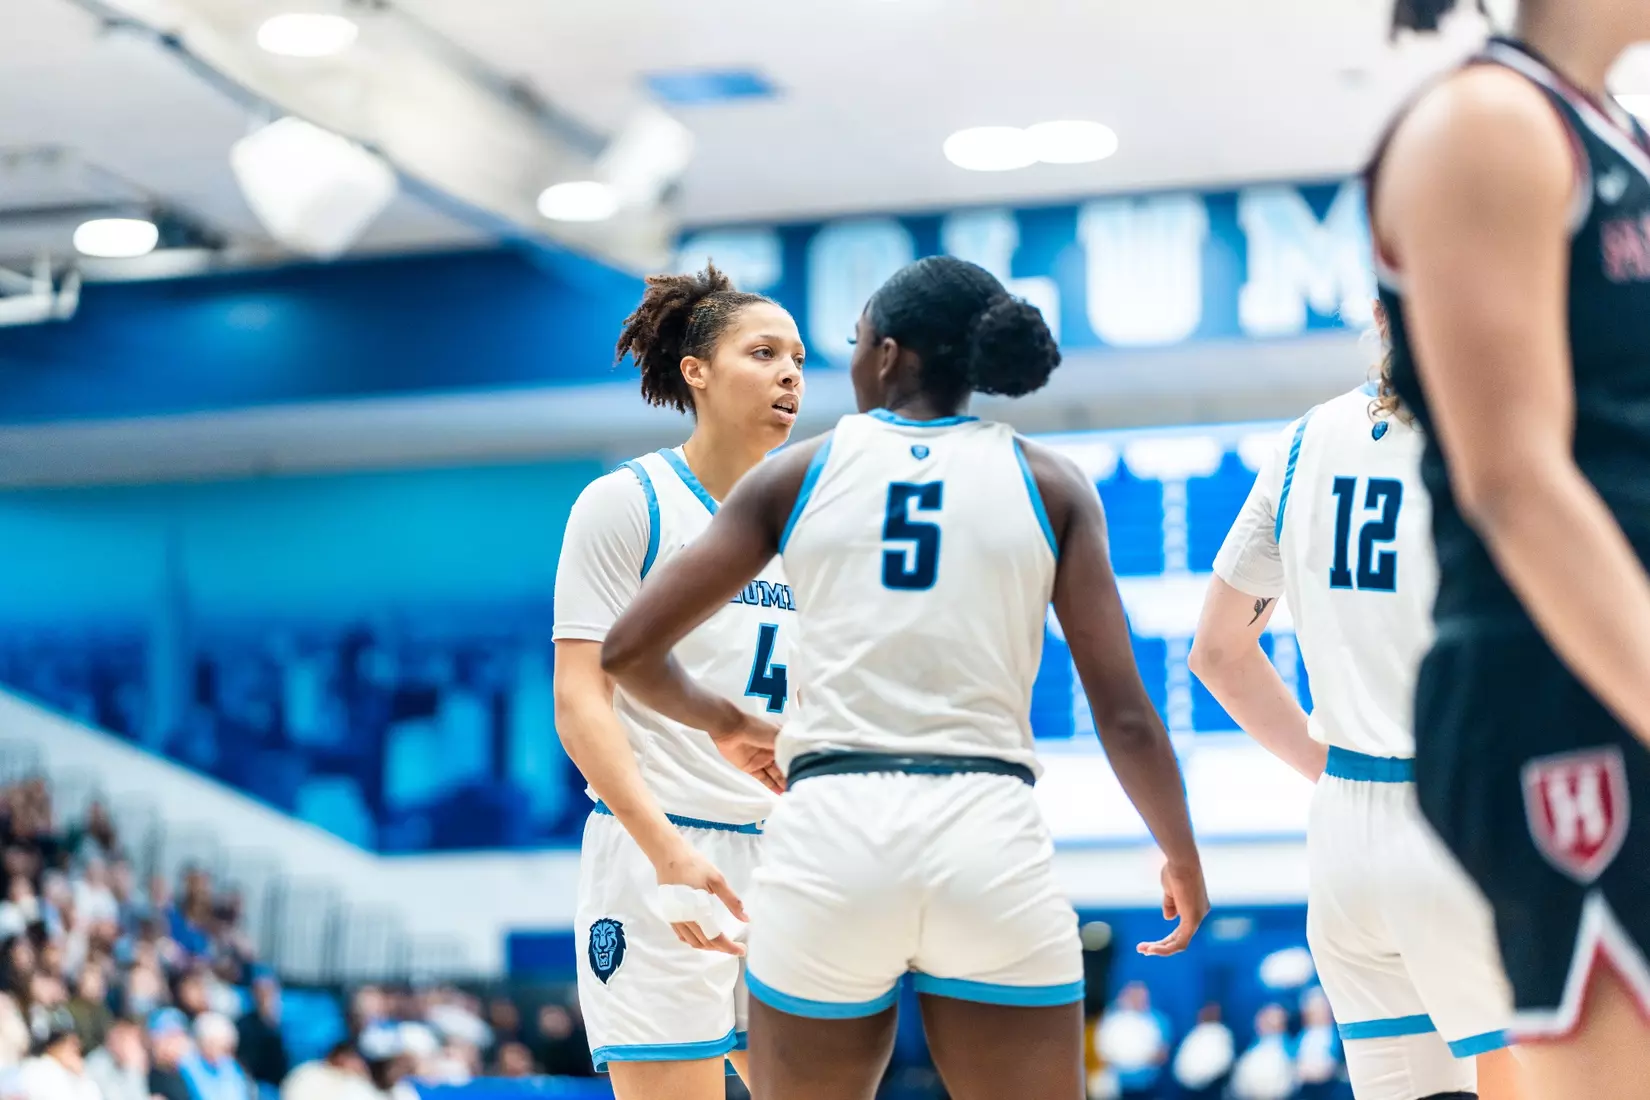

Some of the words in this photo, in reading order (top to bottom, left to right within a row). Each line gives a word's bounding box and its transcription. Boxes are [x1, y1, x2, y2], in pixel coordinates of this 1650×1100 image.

[881, 479, 943, 591] 5
[1329, 475, 1404, 593] 12
[744, 622, 788, 714] 4
